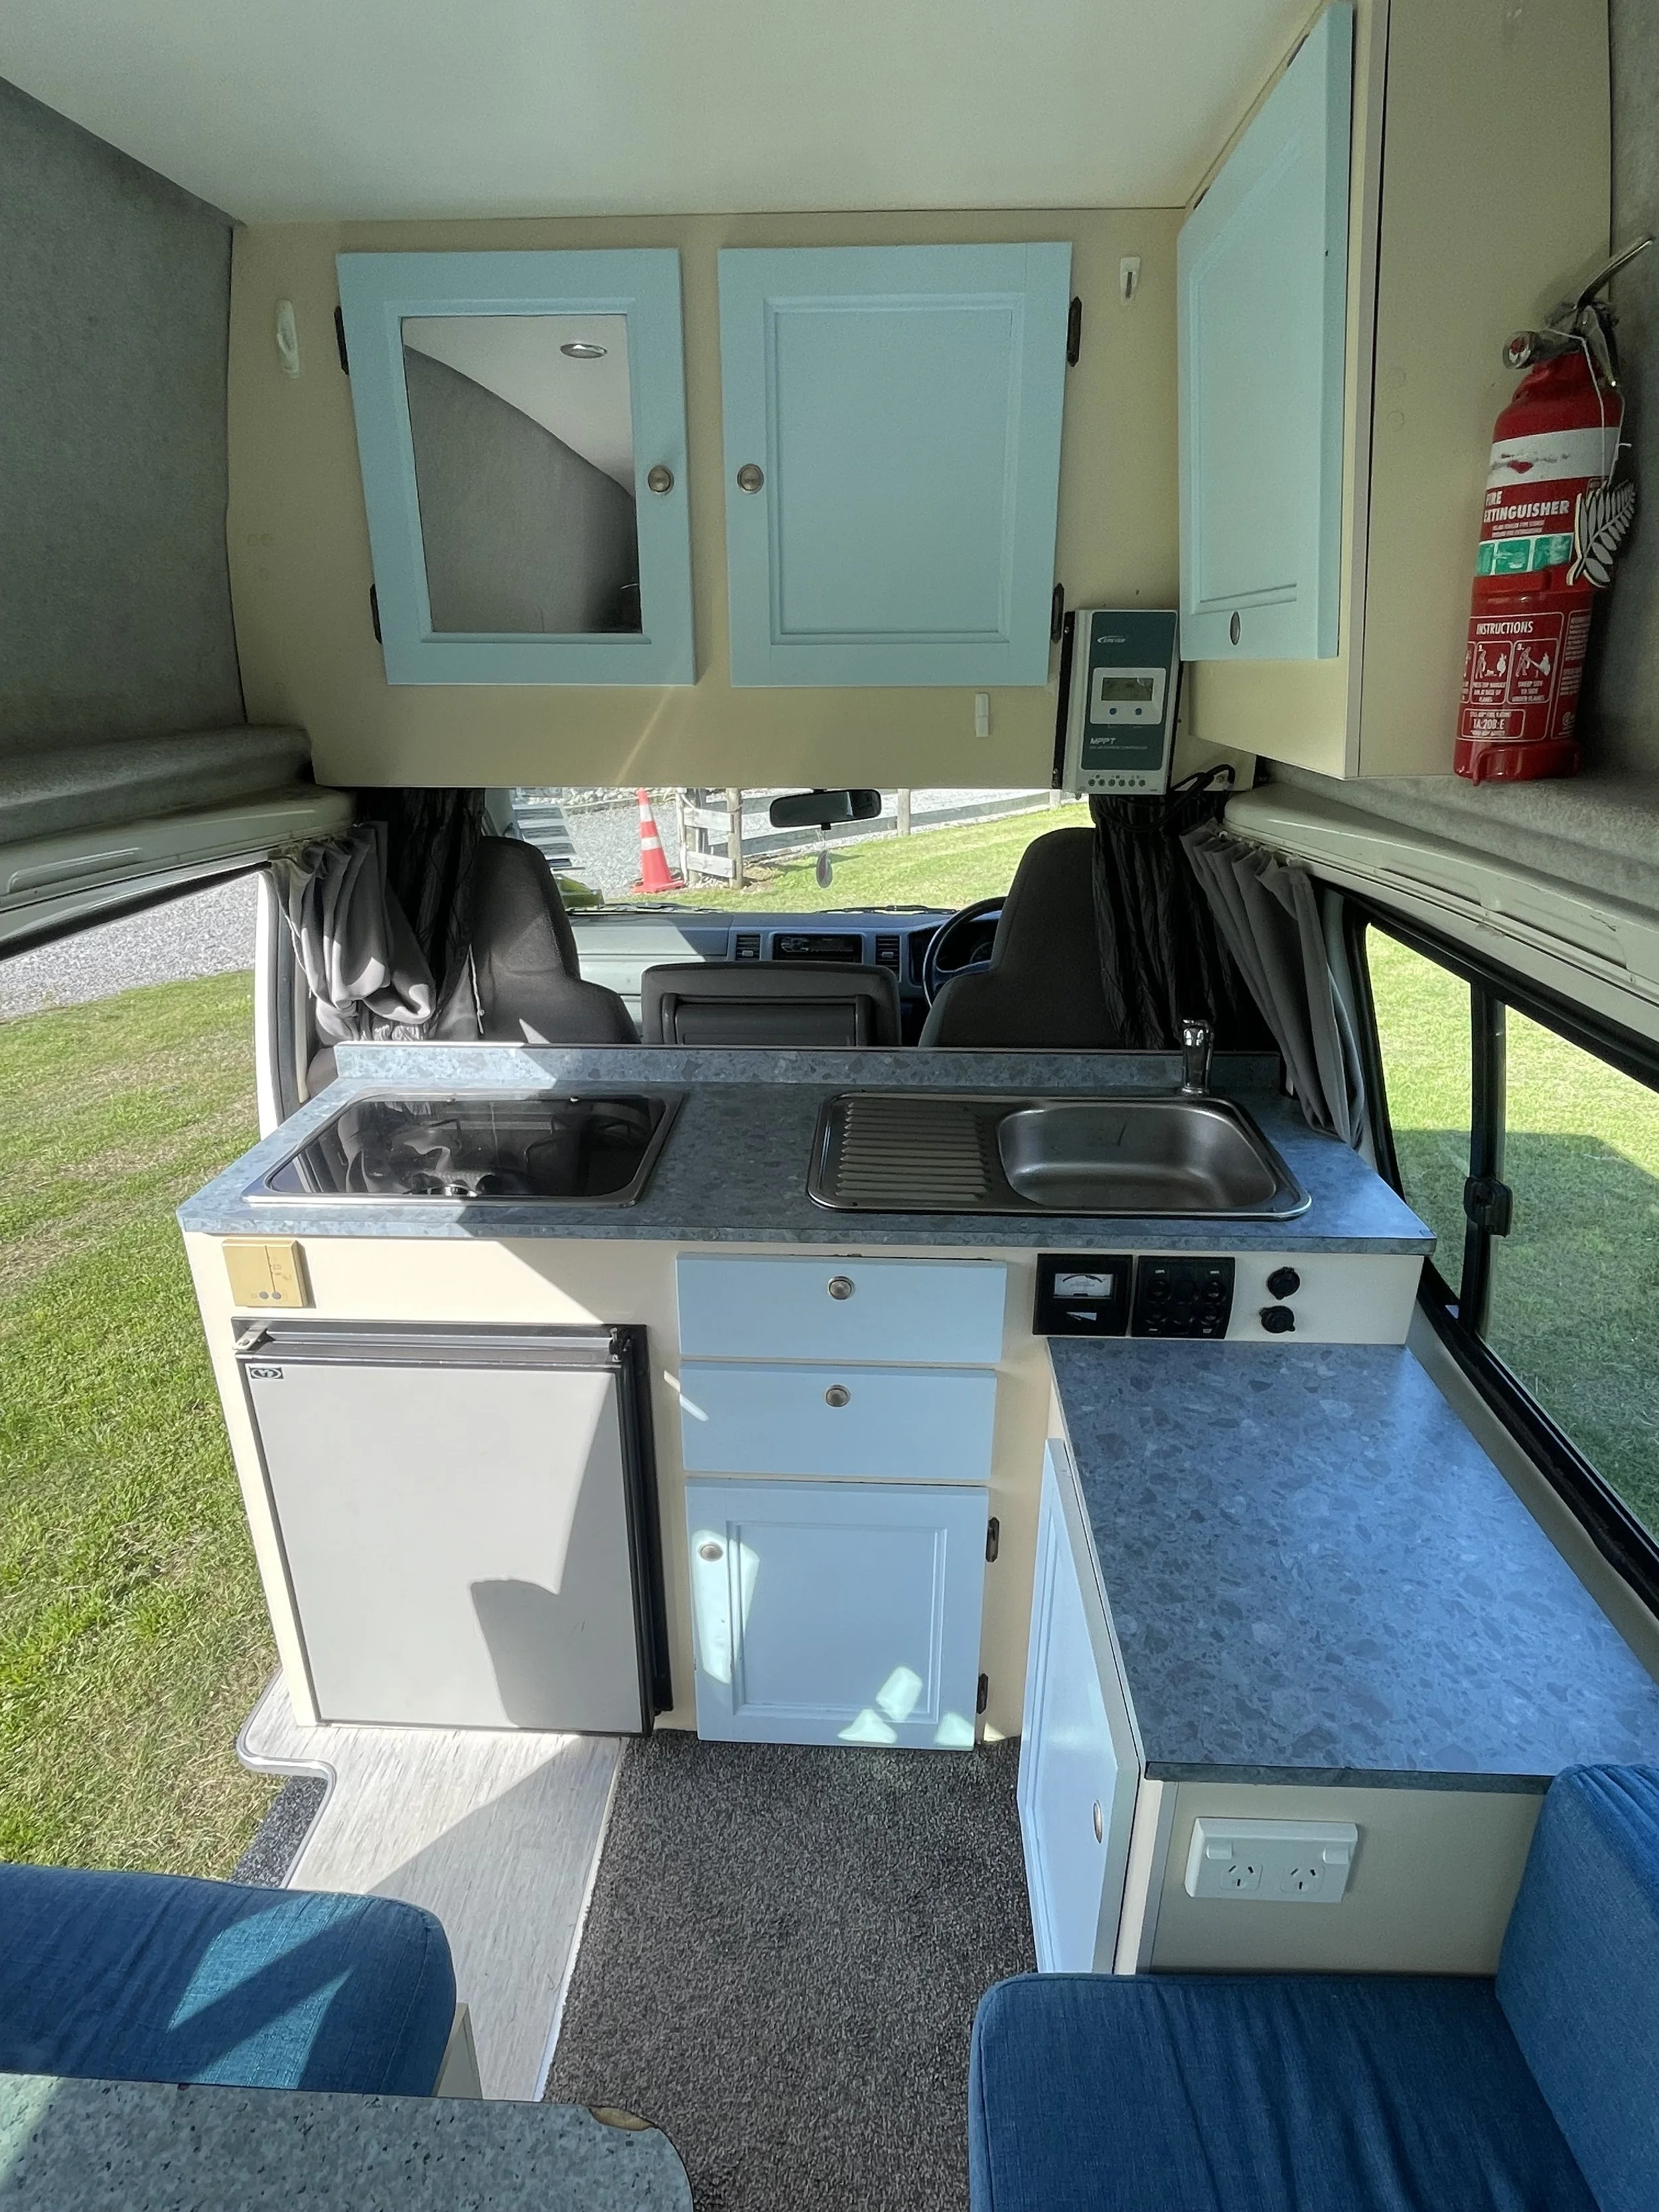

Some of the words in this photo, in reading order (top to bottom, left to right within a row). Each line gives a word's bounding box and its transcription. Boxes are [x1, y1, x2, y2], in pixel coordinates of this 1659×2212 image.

[1485, 490, 1503, 506] FIRE
[1484, 500, 1570, 523] EXTINGUISHER
[1476, 621, 1534, 635] INSTRUCTIONS
